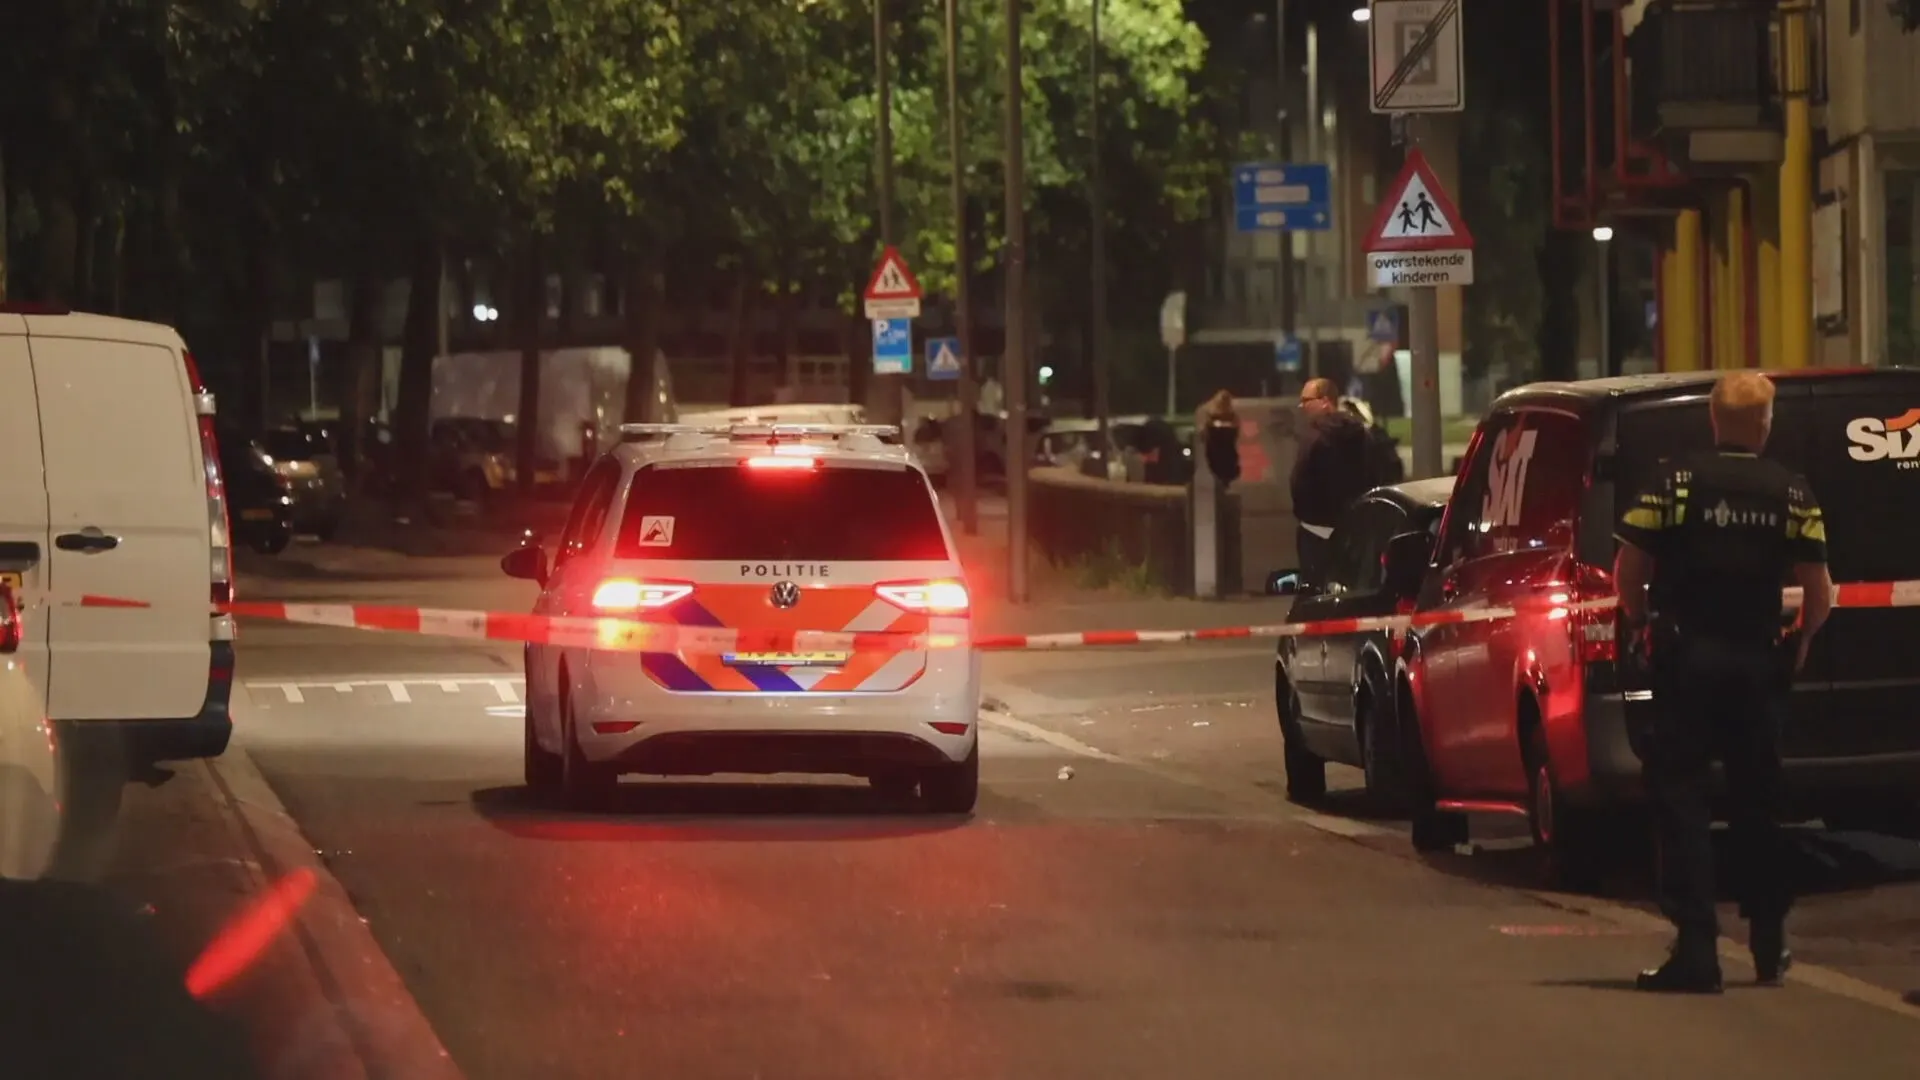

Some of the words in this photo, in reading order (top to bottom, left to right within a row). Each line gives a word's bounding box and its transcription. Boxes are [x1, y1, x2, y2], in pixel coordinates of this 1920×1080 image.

[1375, 253, 1465, 269] overstekende
[1391, 271, 1450, 284] kinderen
[1704, 499, 1777, 527] PLITIE
[741, 564, 829, 577] POLITIE
